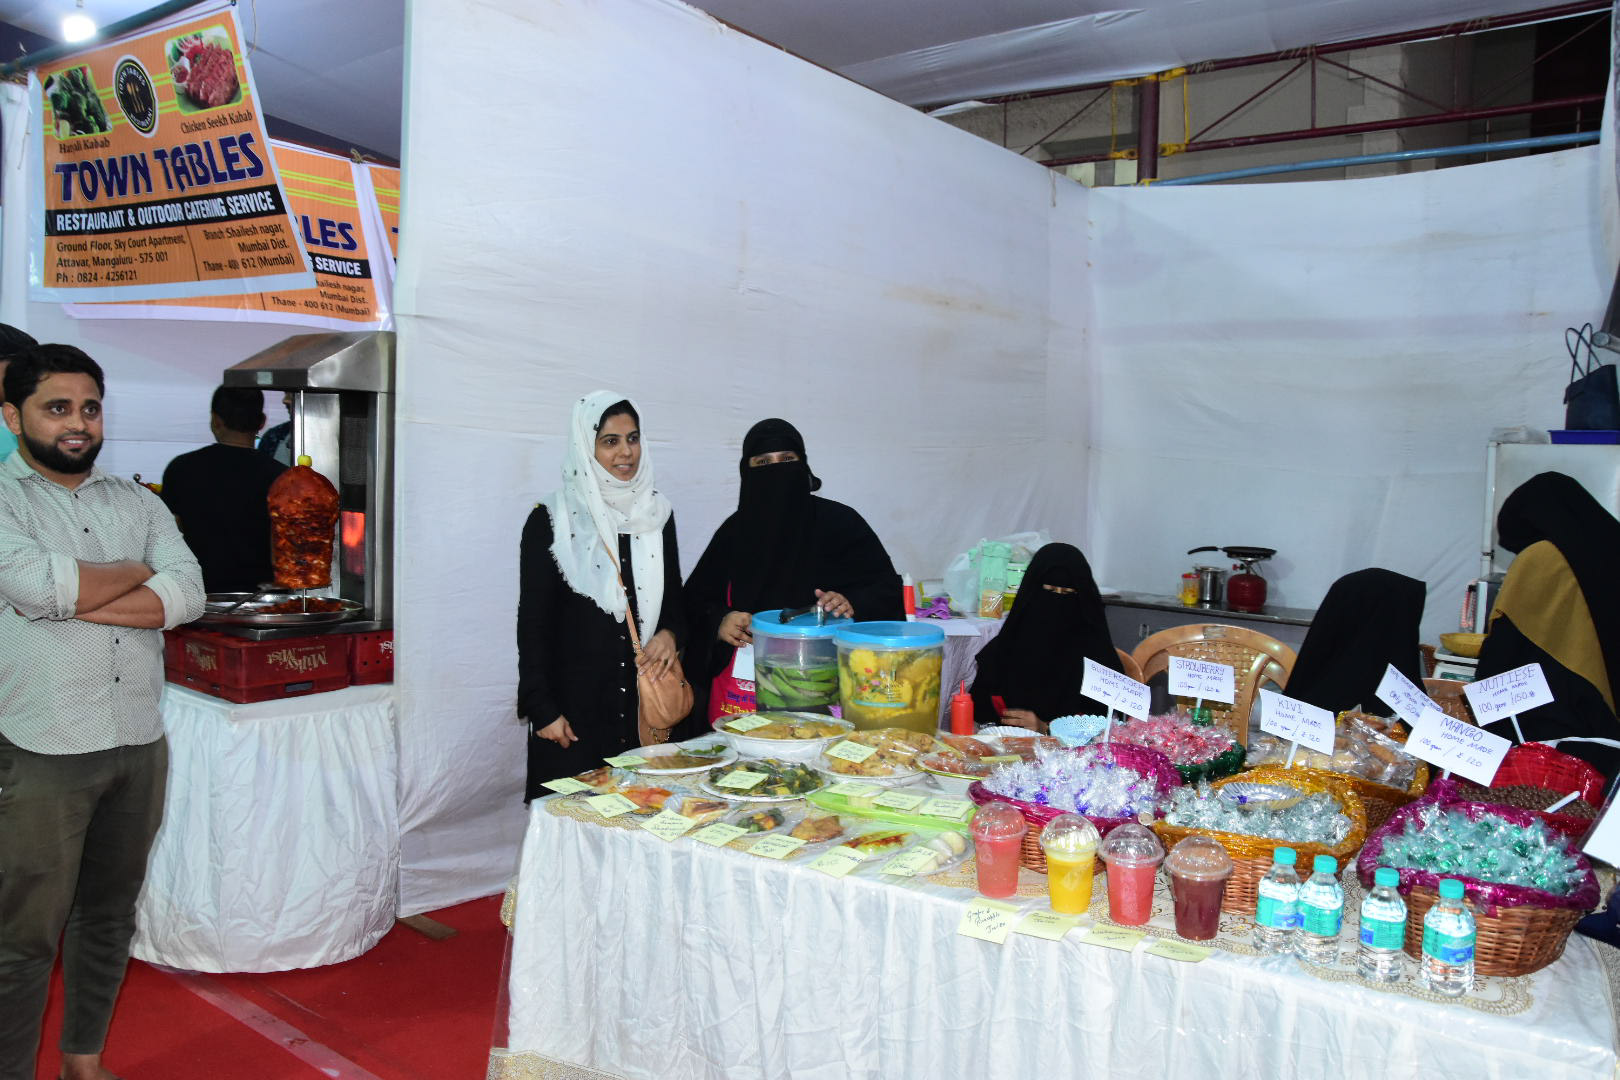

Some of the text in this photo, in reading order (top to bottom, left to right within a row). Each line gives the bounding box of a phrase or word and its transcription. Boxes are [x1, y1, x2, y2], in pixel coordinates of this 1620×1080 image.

[180, 110, 253, 133] Chicken Seekh Kabab
[83, 137, 111, 150] Kabab
[54, 132, 264, 202] TOWN TABLES
[56, 191, 275, 231] RESTAURANT & OUTDOOR CATERING SERVICE
[226, 224, 258, 238] Shailesh
[259, 223, 285, 236] nagar,
[57, 234, 187, 252] Ground Floor, Sky Court Apartment,
[238, 239, 270, 253] Mumbai
[57, 256, 91, 268] Attavar,
[92, 255, 133, 269] Mangaluru
[140, 252, 154, 264] 575
[155, 252, 169, 262] 001
[203, 260, 224, 271] Thane
[241, 257, 256, 269] 612
[257, 252, 295, 269] (Mumbai)
[315, 256, 362, 276] SERVICE
[56, 273, 69, 283] Ph
[77, 272, 98, 282] 0824
[105, 270, 138, 281] 4256121
[320, 290, 349, 302] Mumbai
[272, 296, 296, 307] Thane
[303, 300, 319, 309] 400
[320, 301, 334, 311] 612
[335, 304, 370, 316] (Mumbai)
[287, 651, 328, 674] Milky
[1440, 717, 1483, 742] MANGO
[1441, 732, 1494, 755] HOME MADE
[1466, 756, 1482, 767] 120
